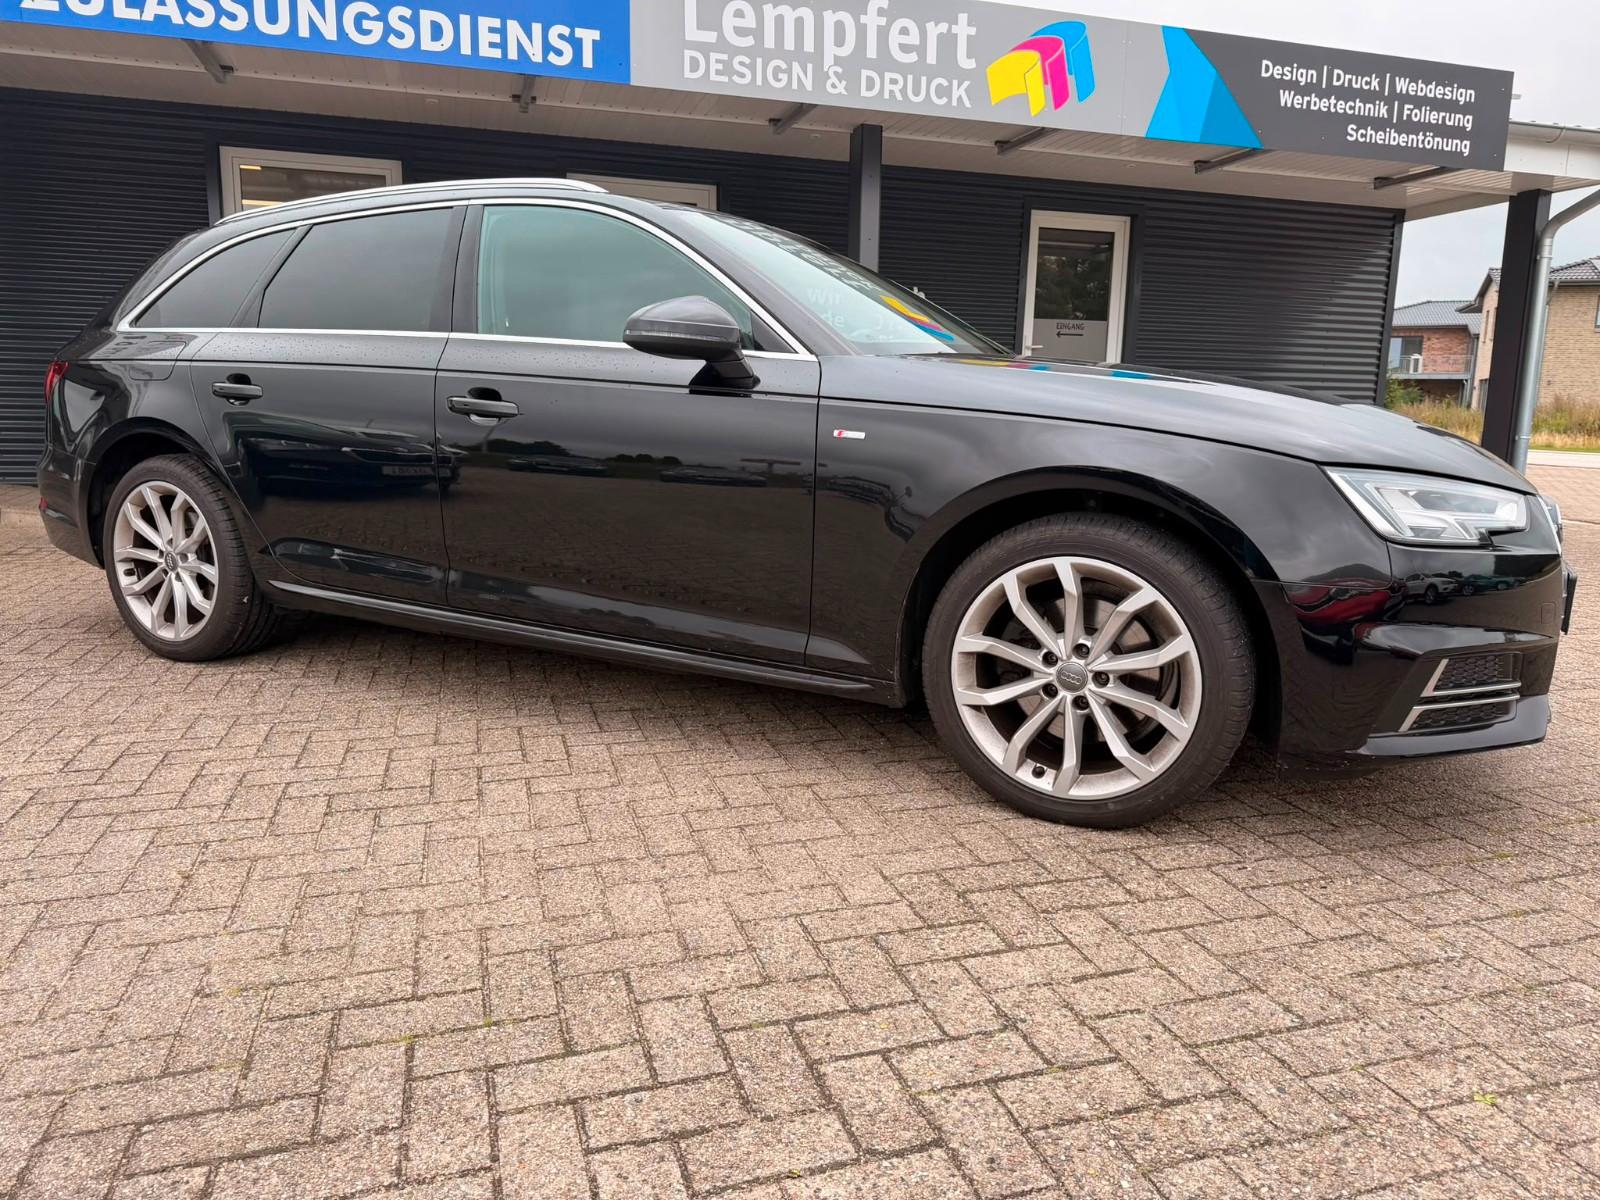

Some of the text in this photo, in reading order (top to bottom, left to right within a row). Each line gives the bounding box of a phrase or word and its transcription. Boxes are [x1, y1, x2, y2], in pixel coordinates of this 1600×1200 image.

[20, 0, 601, 69] LASSUNGSDIENST
[684, 0, 977, 72] Lempfert
[683, 48, 972, 109] DESIGN & DRUCK
[1260, 59, 1318, 86] Design
[1332, 68, 1381, 92] Druck
[1394, 76, 1476, 106] Webdesign
[1279, 89, 1389, 119] Werbetechnik
[1402, 103, 1473, 132] Folierung
[1346, 123, 1471, 157] Scheibentönung
